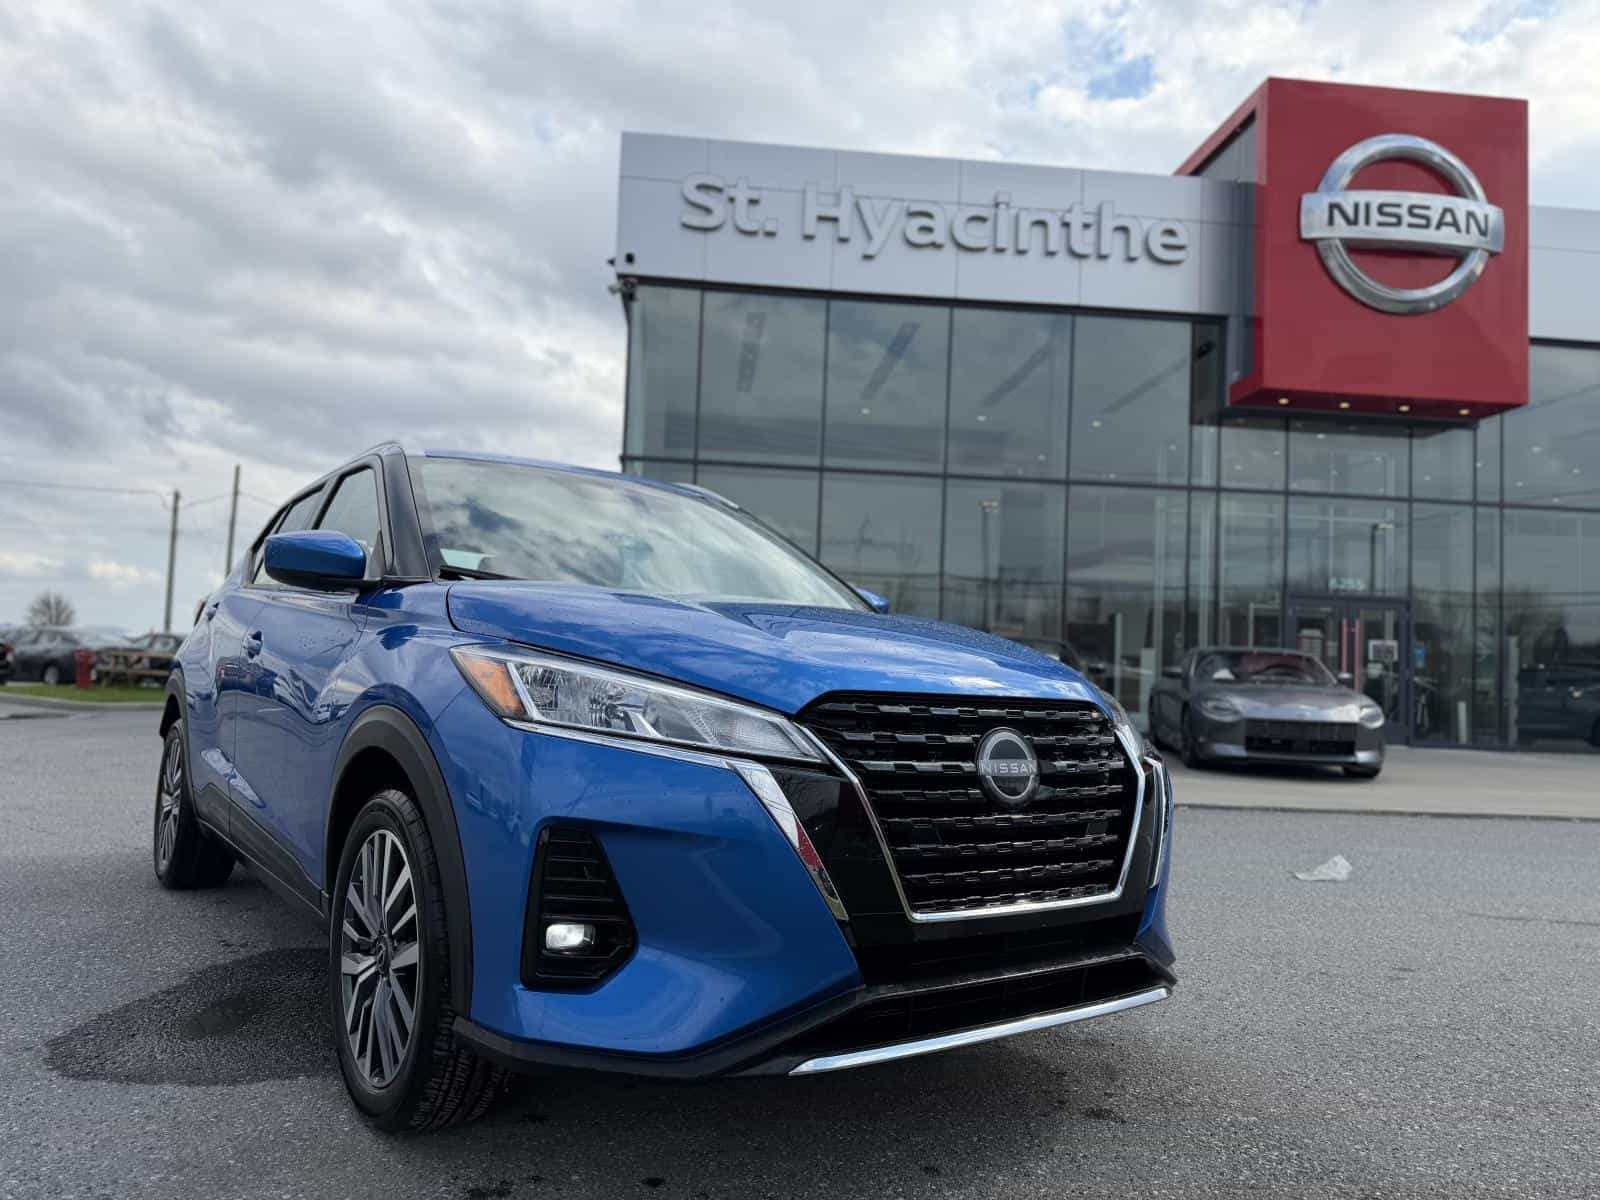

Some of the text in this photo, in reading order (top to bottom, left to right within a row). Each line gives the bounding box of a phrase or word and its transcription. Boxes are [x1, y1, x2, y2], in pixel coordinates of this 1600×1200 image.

[681, 173, 1189, 266] St. Hyacinthe
[1327, 201, 1489, 238] NISSAN
[980, 762, 1037, 774] NISSAN
